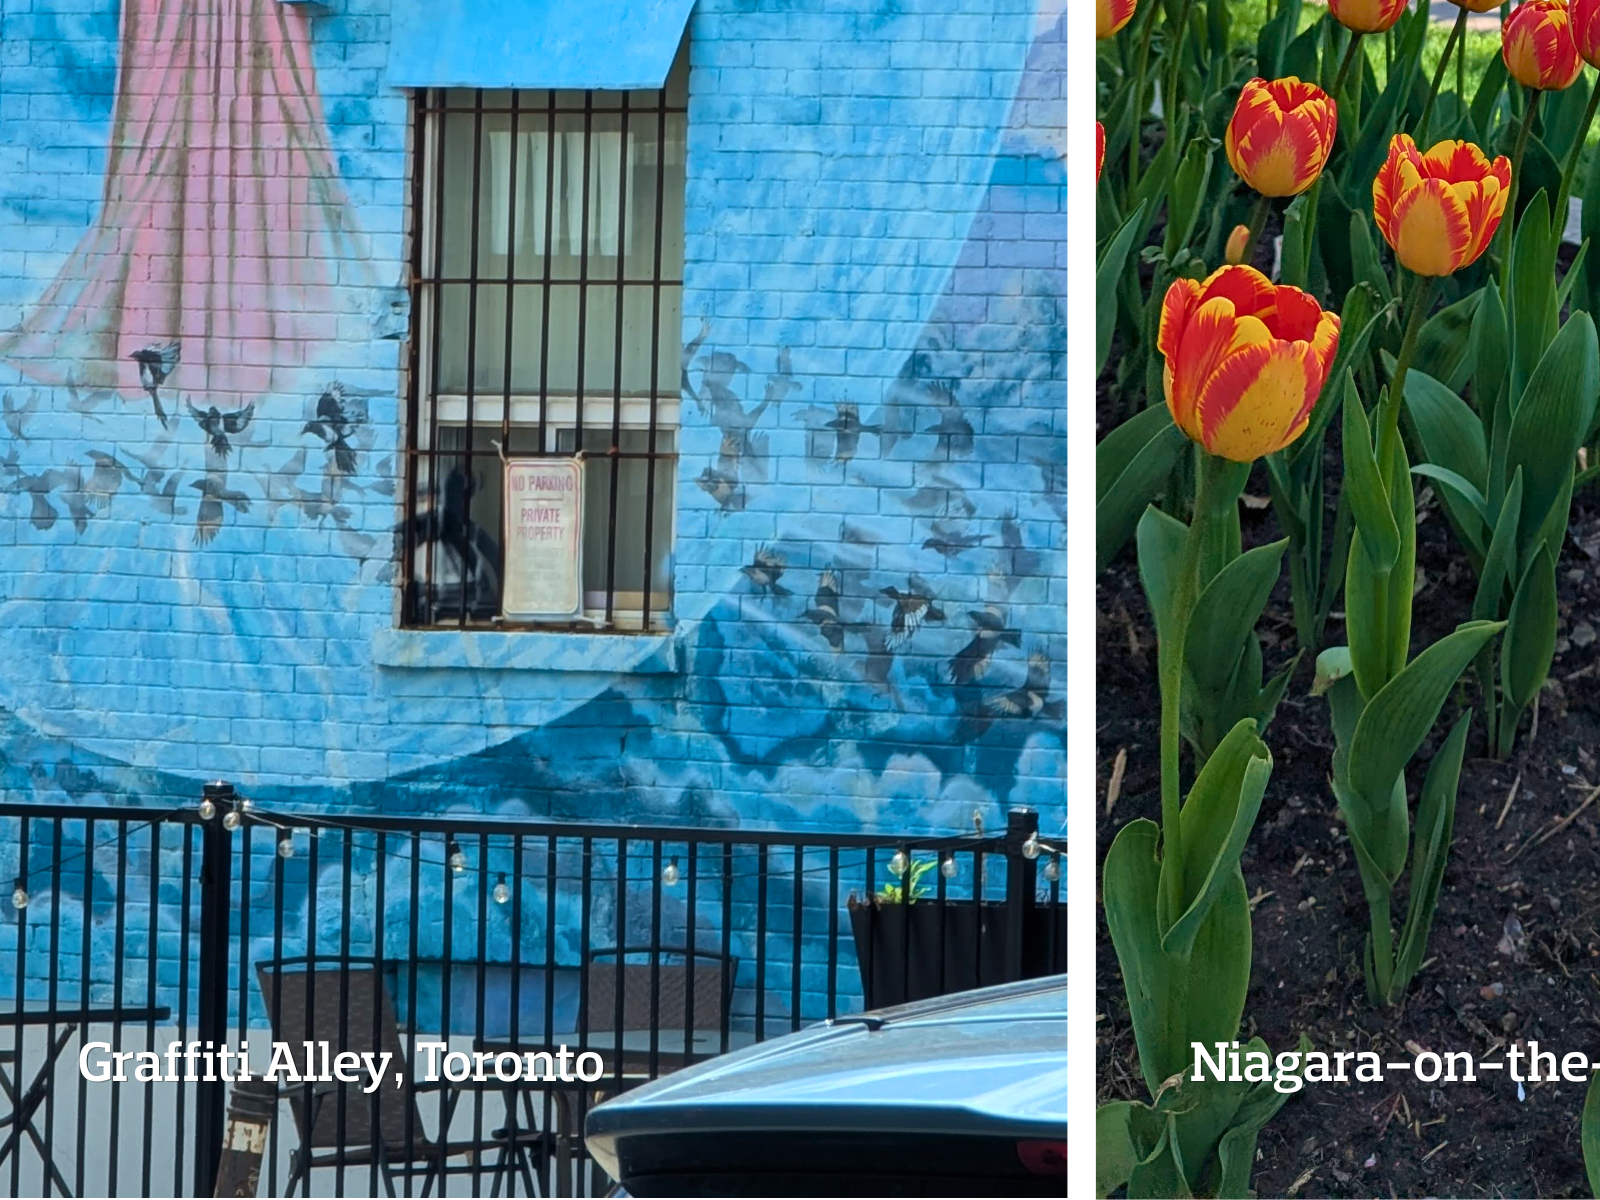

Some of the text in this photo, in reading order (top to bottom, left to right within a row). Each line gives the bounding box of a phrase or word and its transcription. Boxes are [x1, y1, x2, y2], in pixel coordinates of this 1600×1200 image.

[511, 475, 574, 492] NO PARKING
[520, 508, 561, 523] PRIVATE
[516, 526, 565, 540] PROPERTY
